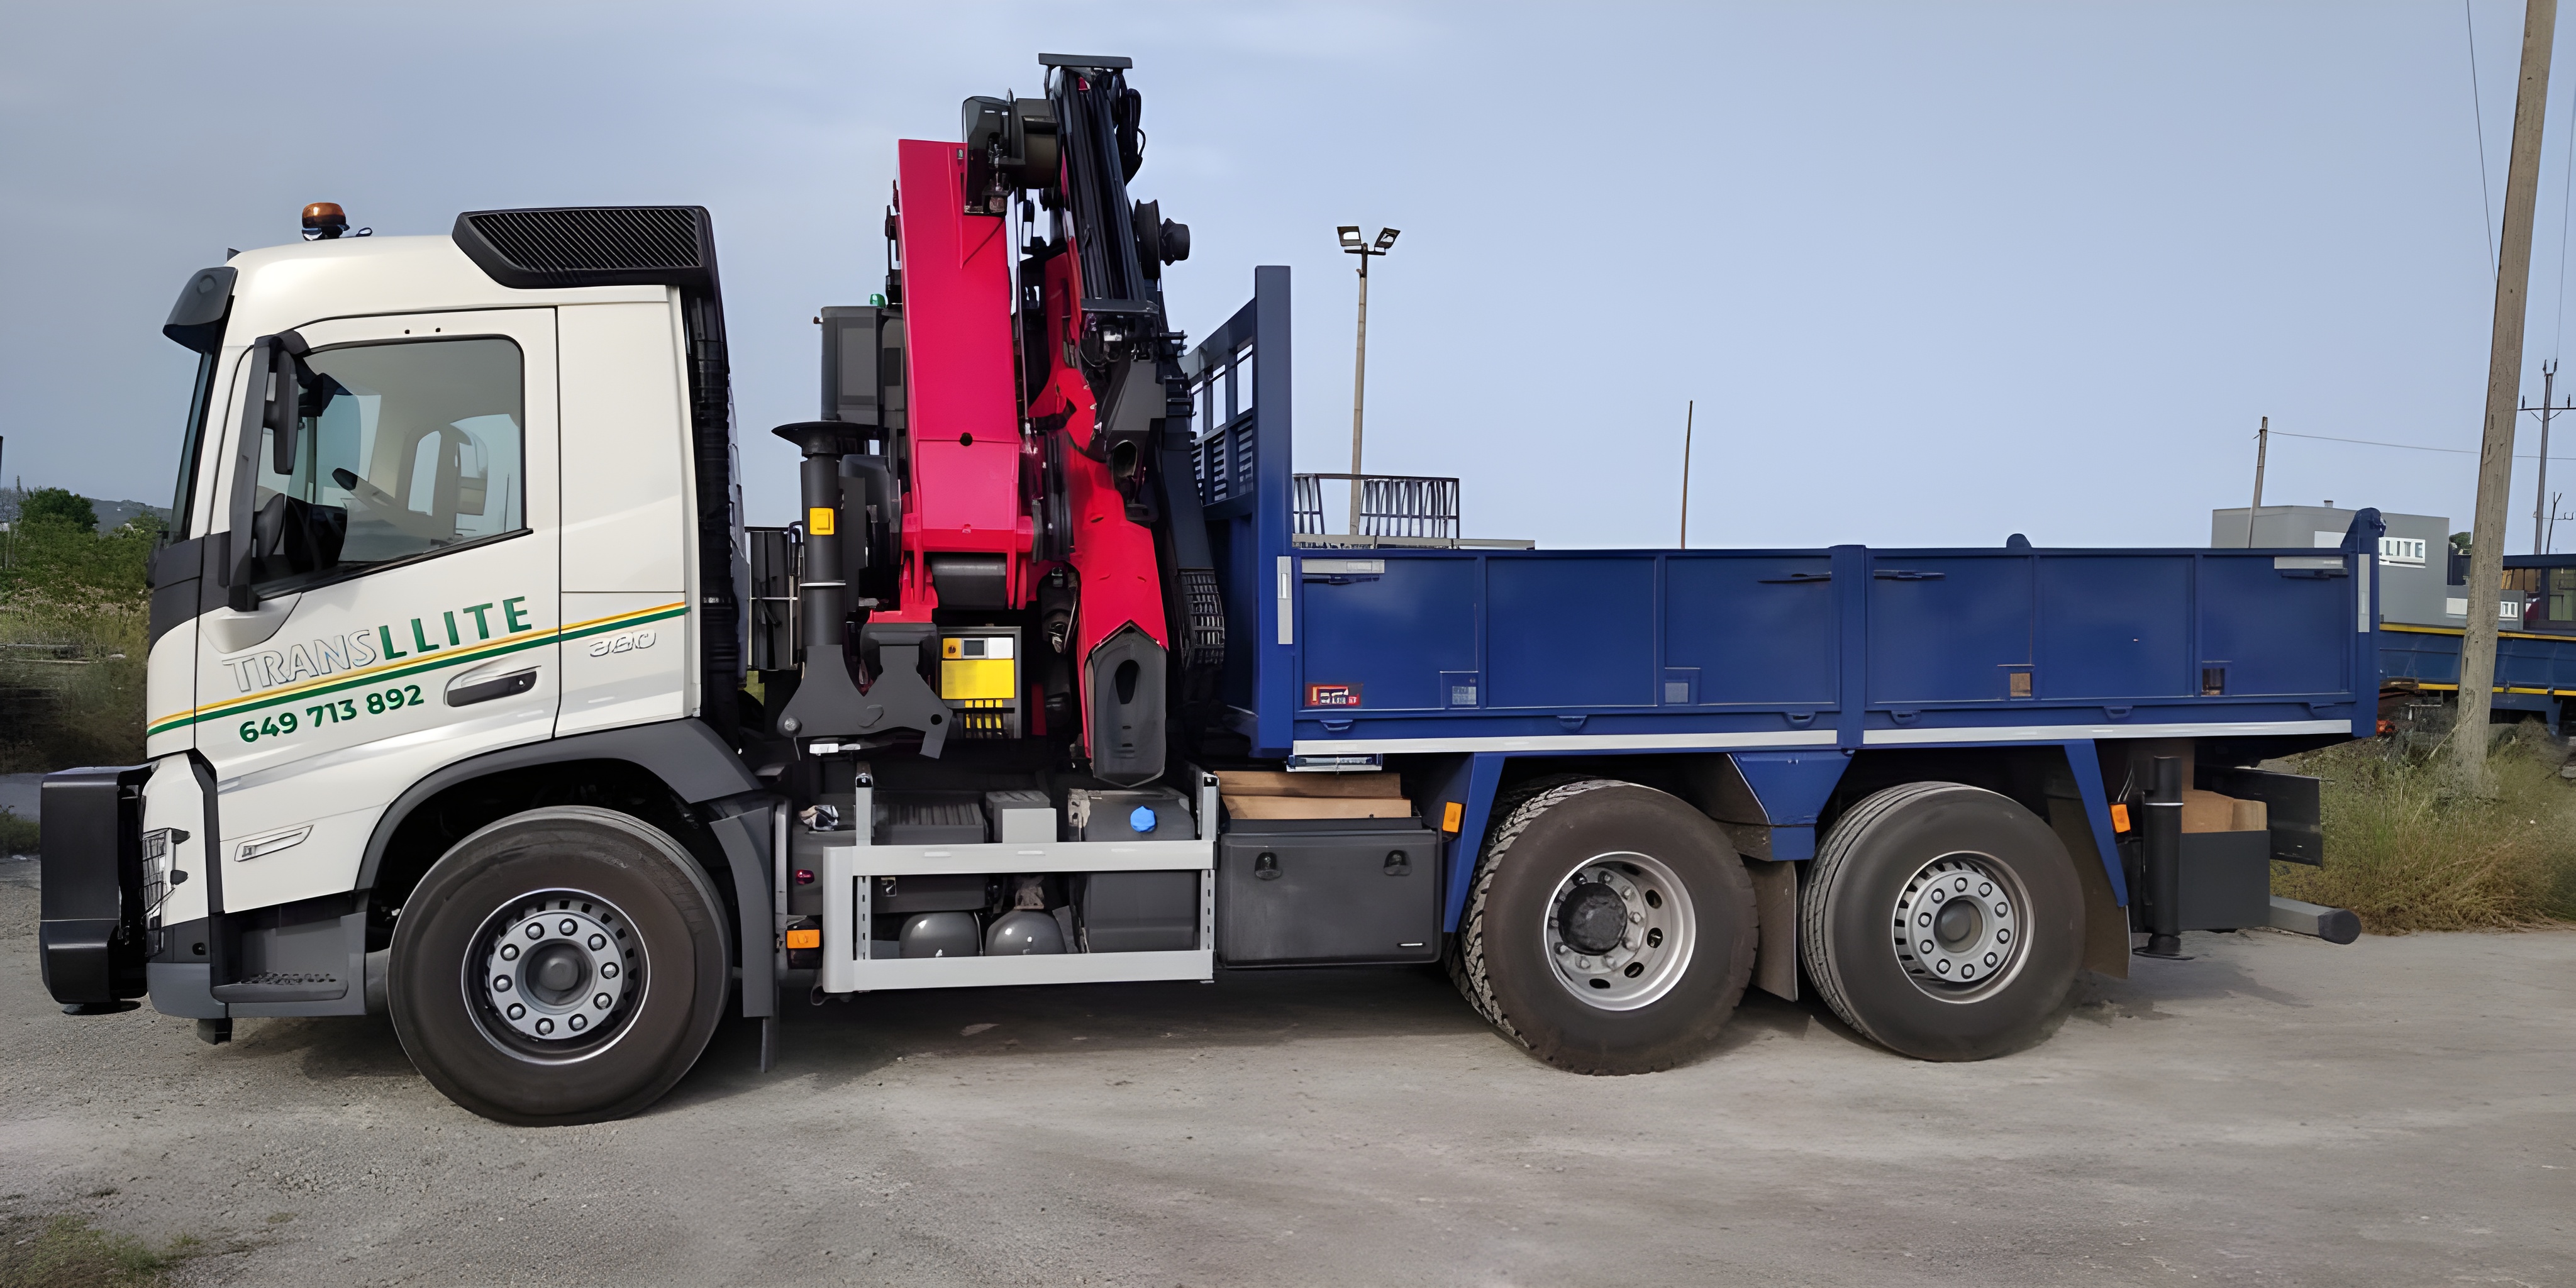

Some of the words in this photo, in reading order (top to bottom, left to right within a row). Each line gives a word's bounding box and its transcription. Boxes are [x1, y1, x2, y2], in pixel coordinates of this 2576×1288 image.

[240, 712, 298, 743] 649
[306, 699, 357, 727] 713
[366, 685, 425, 714] 892
